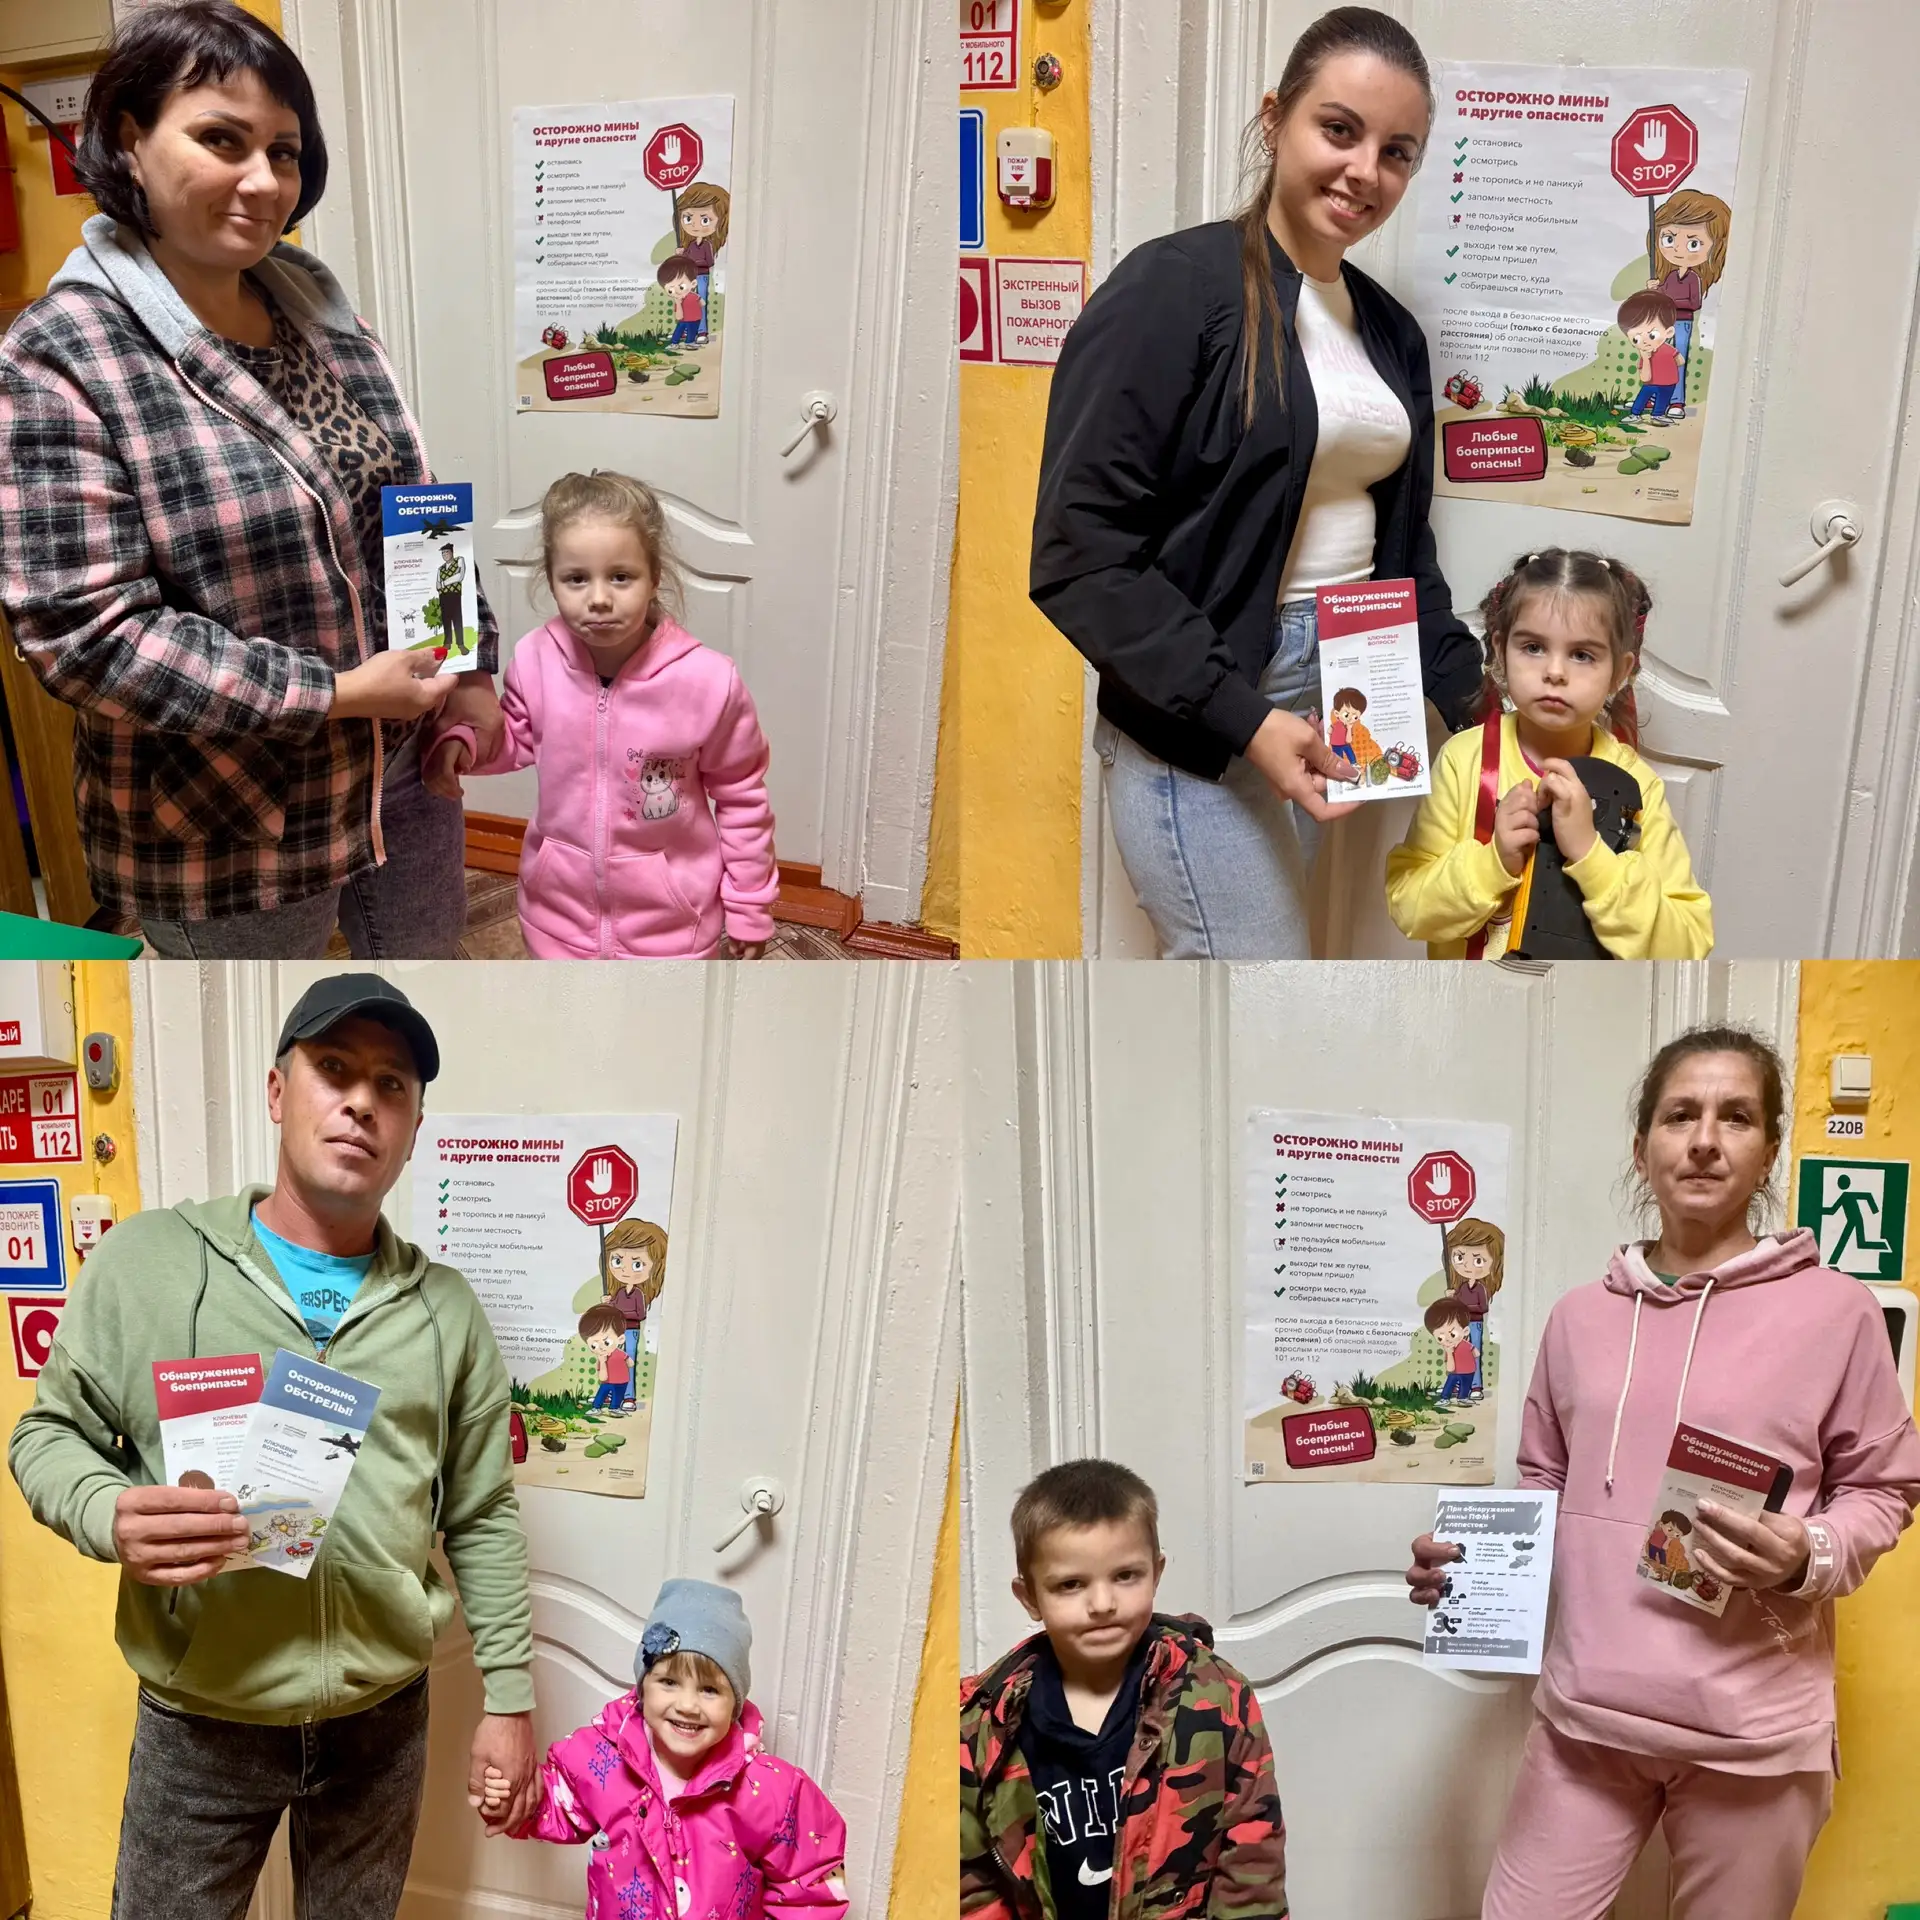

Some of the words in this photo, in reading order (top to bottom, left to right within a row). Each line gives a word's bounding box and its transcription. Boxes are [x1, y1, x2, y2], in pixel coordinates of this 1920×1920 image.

[971, 1, 996, 30] 01
[964, 52, 1003, 81] 112
[1455, 90, 1554, 105] ОСТОРОЖНО
[1558, 95, 1609, 107] МИНЫ
[1458, 108, 1467, 116] и
[1470, 108, 1522, 120] другие
[1526, 111, 1604, 122] опасности
[533, 124, 601, 135] ОСТОРОЖНО
[604, 122, 639, 132] МИНЫ
[544, 137, 580, 147] другие
[583, 134, 636, 143] опасности
[1472, 139, 1523, 148] остановись
[1470, 158, 1518, 167] осмотрись
[659, 166, 689, 180] STOP
[1633, 164, 1676, 181] STOP
[1482, 177, 1523, 186] торопись
[1547, 180, 1583, 190] паникуй
[1467, 194, 1505, 203] запомни
[1508, 196, 1552, 205] местность
[1479, 213, 1523, 223] пользуйся
[1526, 215, 1578, 224] мобильным
[1465, 224, 1514, 233] телефоном
[1464, 242, 1495, 250] выходи
[1530, 246, 1558, 255] путем,
[1462, 254, 1500, 262] которым
[1503, 256, 1537, 264] пришел
[1462, 272, 1498, 280] осмотри
[1531, 276, 1550, 284] куда
[1003, 280, 1079, 292] ЭКСТРЕННЫЙ
[1460, 282, 1518, 293] собираешься
[1521, 287, 1563, 296] наступить
[1021, 299, 1060, 310] ВЫЗОВ
[1443, 308, 1468, 316] после
[1470, 310, 1500, 318] выхода
[1510, 311, 1561, 322] безопасное
[1442, 319, 1472, 328] срочно
[1475, 321, 1508, 330] сообщи
[1510, 324, 1542, 332] (только
[1552, 325, 1608, 336] безопасного
[1440, 330, 1492, 340] расстояния)
[1508, 335, 1544, 343] опасной
[1546, 338, 1581, 347] находке
[1439, 351, 1453, 359] 101
[1440, 342, 1481, 350] взрослым
[1502, 346, 1537, 354] позвони
[1553, 349, 1588, 359] номеру:
[563, 363, 595, 372] Любые
[554, 371, 607, 383] боеприпасы
[564, 380, 599, 391] опасны!
[1471, 431, 1518, 442] Любые
[1456, 445, 1535, 457] боеприпасы
[1470, 458, 1521, 470] опасны!
[396, 494, 456, 503] Осторожно,
[398, 505, 458, 516] ОБСТРЕЛЫ!
[1323, 590, 1410, 604] Обнаруженные
[1333, 602, 1402, 613] боеприпасы
[43, 1089, 63, 1114] 01
[1828, 1121, 1864, 1135] 220В
[40, 1131, 72, 1155] 112
[437, 1138, 519, 1150] ОСТОРОЖНО
[522, 1139, 564, 1150] МИНЫ
[1273, 1134, 1358, 1149] ОСТОРОЖНО
[1361, 1141, 1403, 1152] МИНЫ
[450, 1153, 492, 1164] другие
[496, 1154, 560, 1163] опасности
[1287, 1149, 1333, 1161] другие
[1336, 1153, 1400, 1164] опасности
[1291, 1175, 1335, 1183] остановись
[452, 1195, 491, 1203] осмотрись
[1290, 1190, 1331, 1199] осмотрись
[585, 1197, 621, 1212] STOP
[1426, 1198, 1460, 1212] STOP
[7, 1211, 39, 1219] ПОЖАРЕ
[1302, 1206, 1337, 1215] торопись
[1357, 1209, 1387, 1217] паникуй
[1290, 1221, 1322, 1229] запомни
[1301, 1236, 1340, 1245] пользуйся
[1341, 1238, 1385, 1246] мобильным
[8, 1237, 33, 1260] 01
[1290, 1245, 1332, 1254] телефоном
[159, 1366, 255, 1382] Обнаруженные
[171, 1378, 247, 1392] боеприпасы
[288, 1369, 357, 1404] Осторожно,
[284, 1384, 353, 1417] ОБСТРЕЛЫ!
[1308, 1420, 1349, 1433] Любые
[1296, 1429, 1365, 1445] боеприпасы
[1309, 1442, 1354, 1456] опасны!
[1680, 1434, 1771, 1472] Обнаруженные
[1686, 1445, 1759, 1477] боеприпасы
